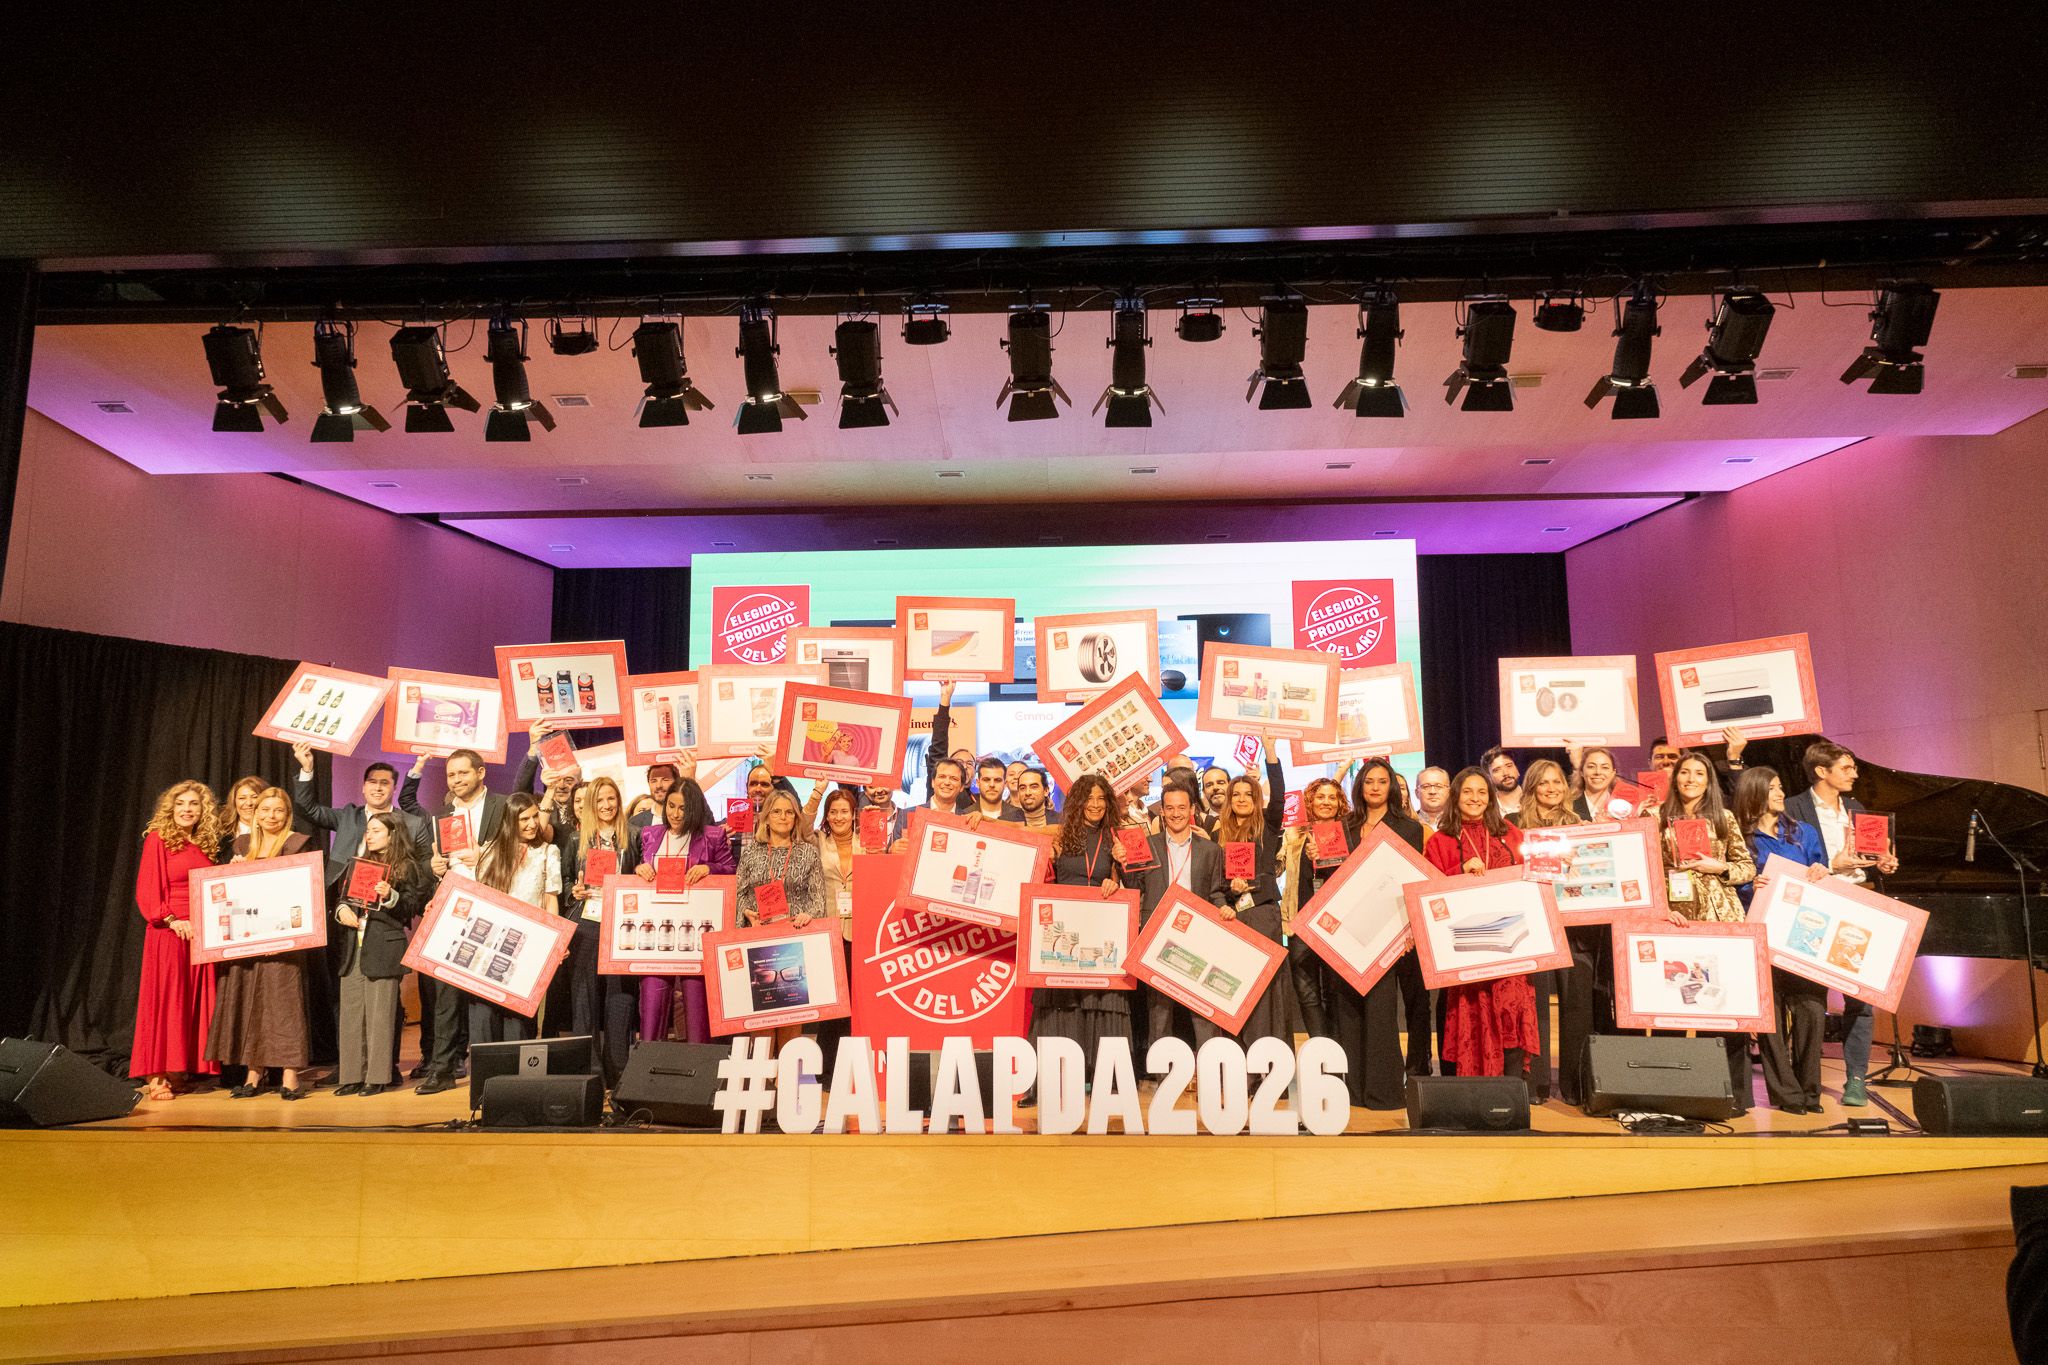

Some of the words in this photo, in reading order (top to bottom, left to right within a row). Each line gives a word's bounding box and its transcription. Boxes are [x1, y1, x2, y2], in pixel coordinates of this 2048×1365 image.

[729, 600, 781, 628] ELEGIDO
[1311, 594, 1364, 622] ELEGIDO
[726, 612, 795, 646] PRODUCTO
[1308, 607, 1380, 642] PRODUCTO
[742, 648, 768, 662] DEL
[1326, 642, 1354, 656] DEL
[1355, 628, 1378, 653] AÑO
[1014, 711, 1054, 721] Emma
[914, 987, 964, 1016] DEL
[970, 960, 1011, 1010] AÑO
[714, 1035, 1350, 1136] #GALAPDA2026
